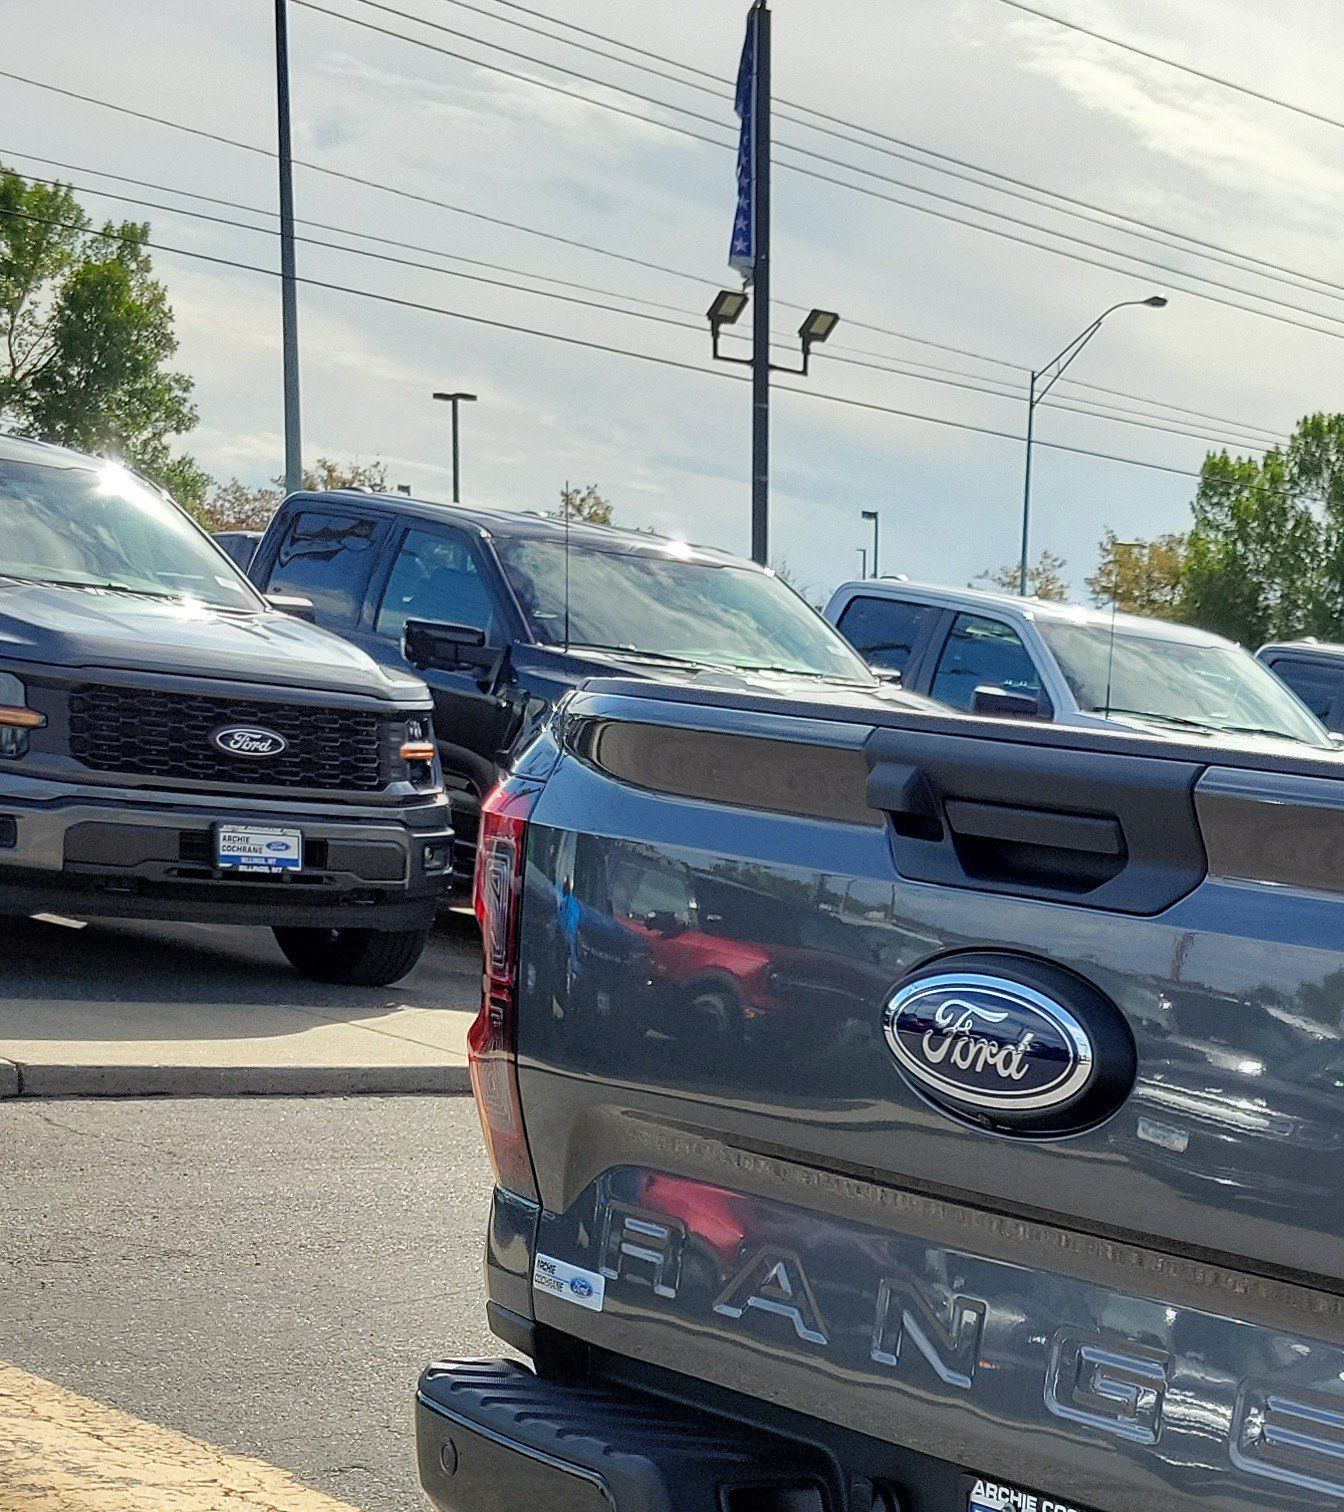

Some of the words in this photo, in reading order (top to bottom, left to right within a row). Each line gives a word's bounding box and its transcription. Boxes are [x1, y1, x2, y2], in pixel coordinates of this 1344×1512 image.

[230, 732, 273, 751] Ford
[221, 844, 264, 854] COCHRANE
[222, 835, 251, 844] ARCHIE
[922, 999, 1036, 1081] Ford
[970, 1479, 1038, 1512] ARCHIE
